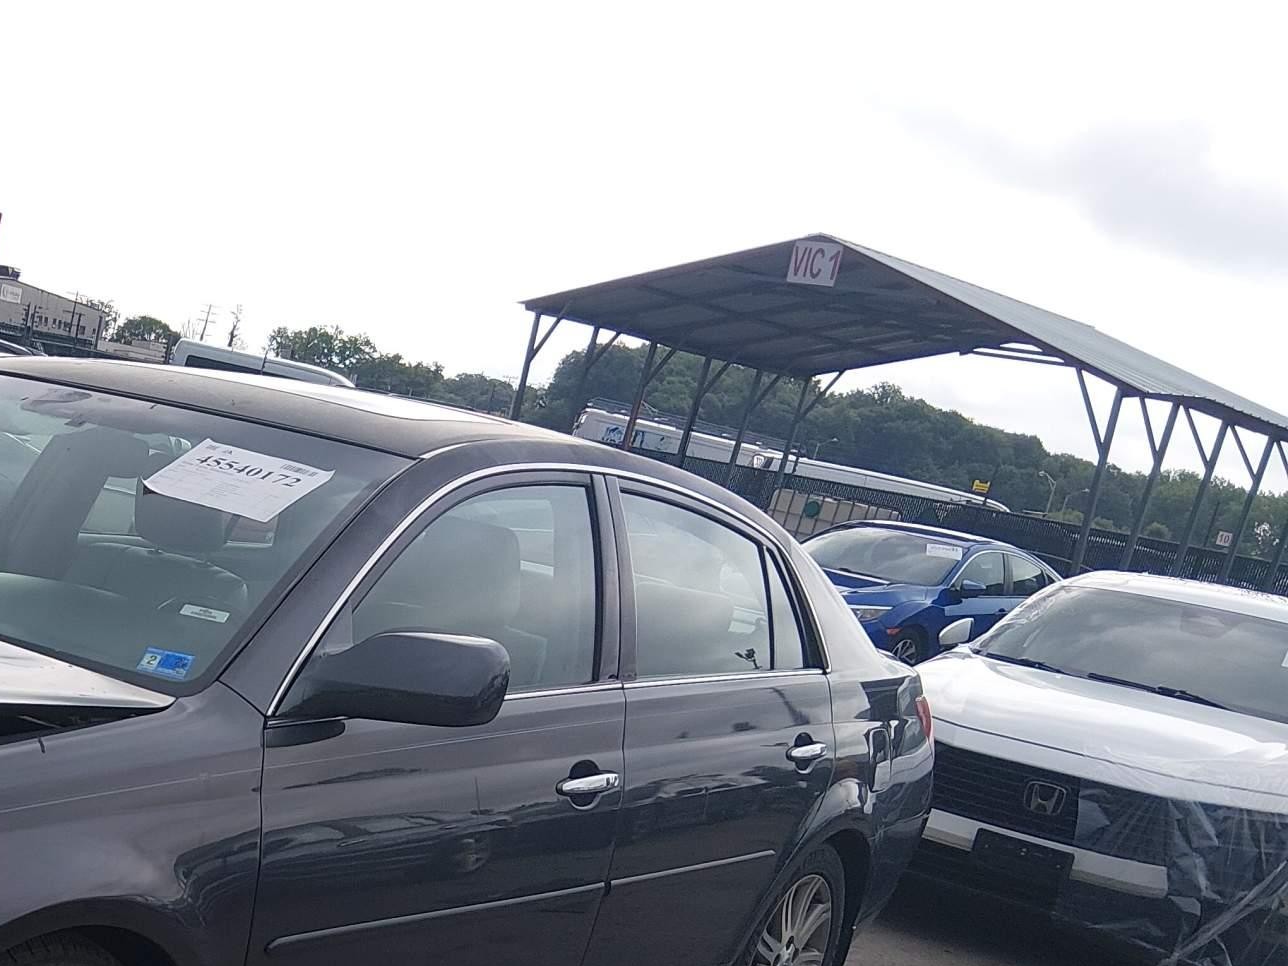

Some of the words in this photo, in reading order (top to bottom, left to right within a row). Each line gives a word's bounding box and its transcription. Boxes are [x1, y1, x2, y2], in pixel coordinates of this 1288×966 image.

[793, 246, 825, 279] VIC
[828, 250, 841, 281] 1
[196, 455, 303, 488] 45540172
[146, 654, 158, 666] 2
